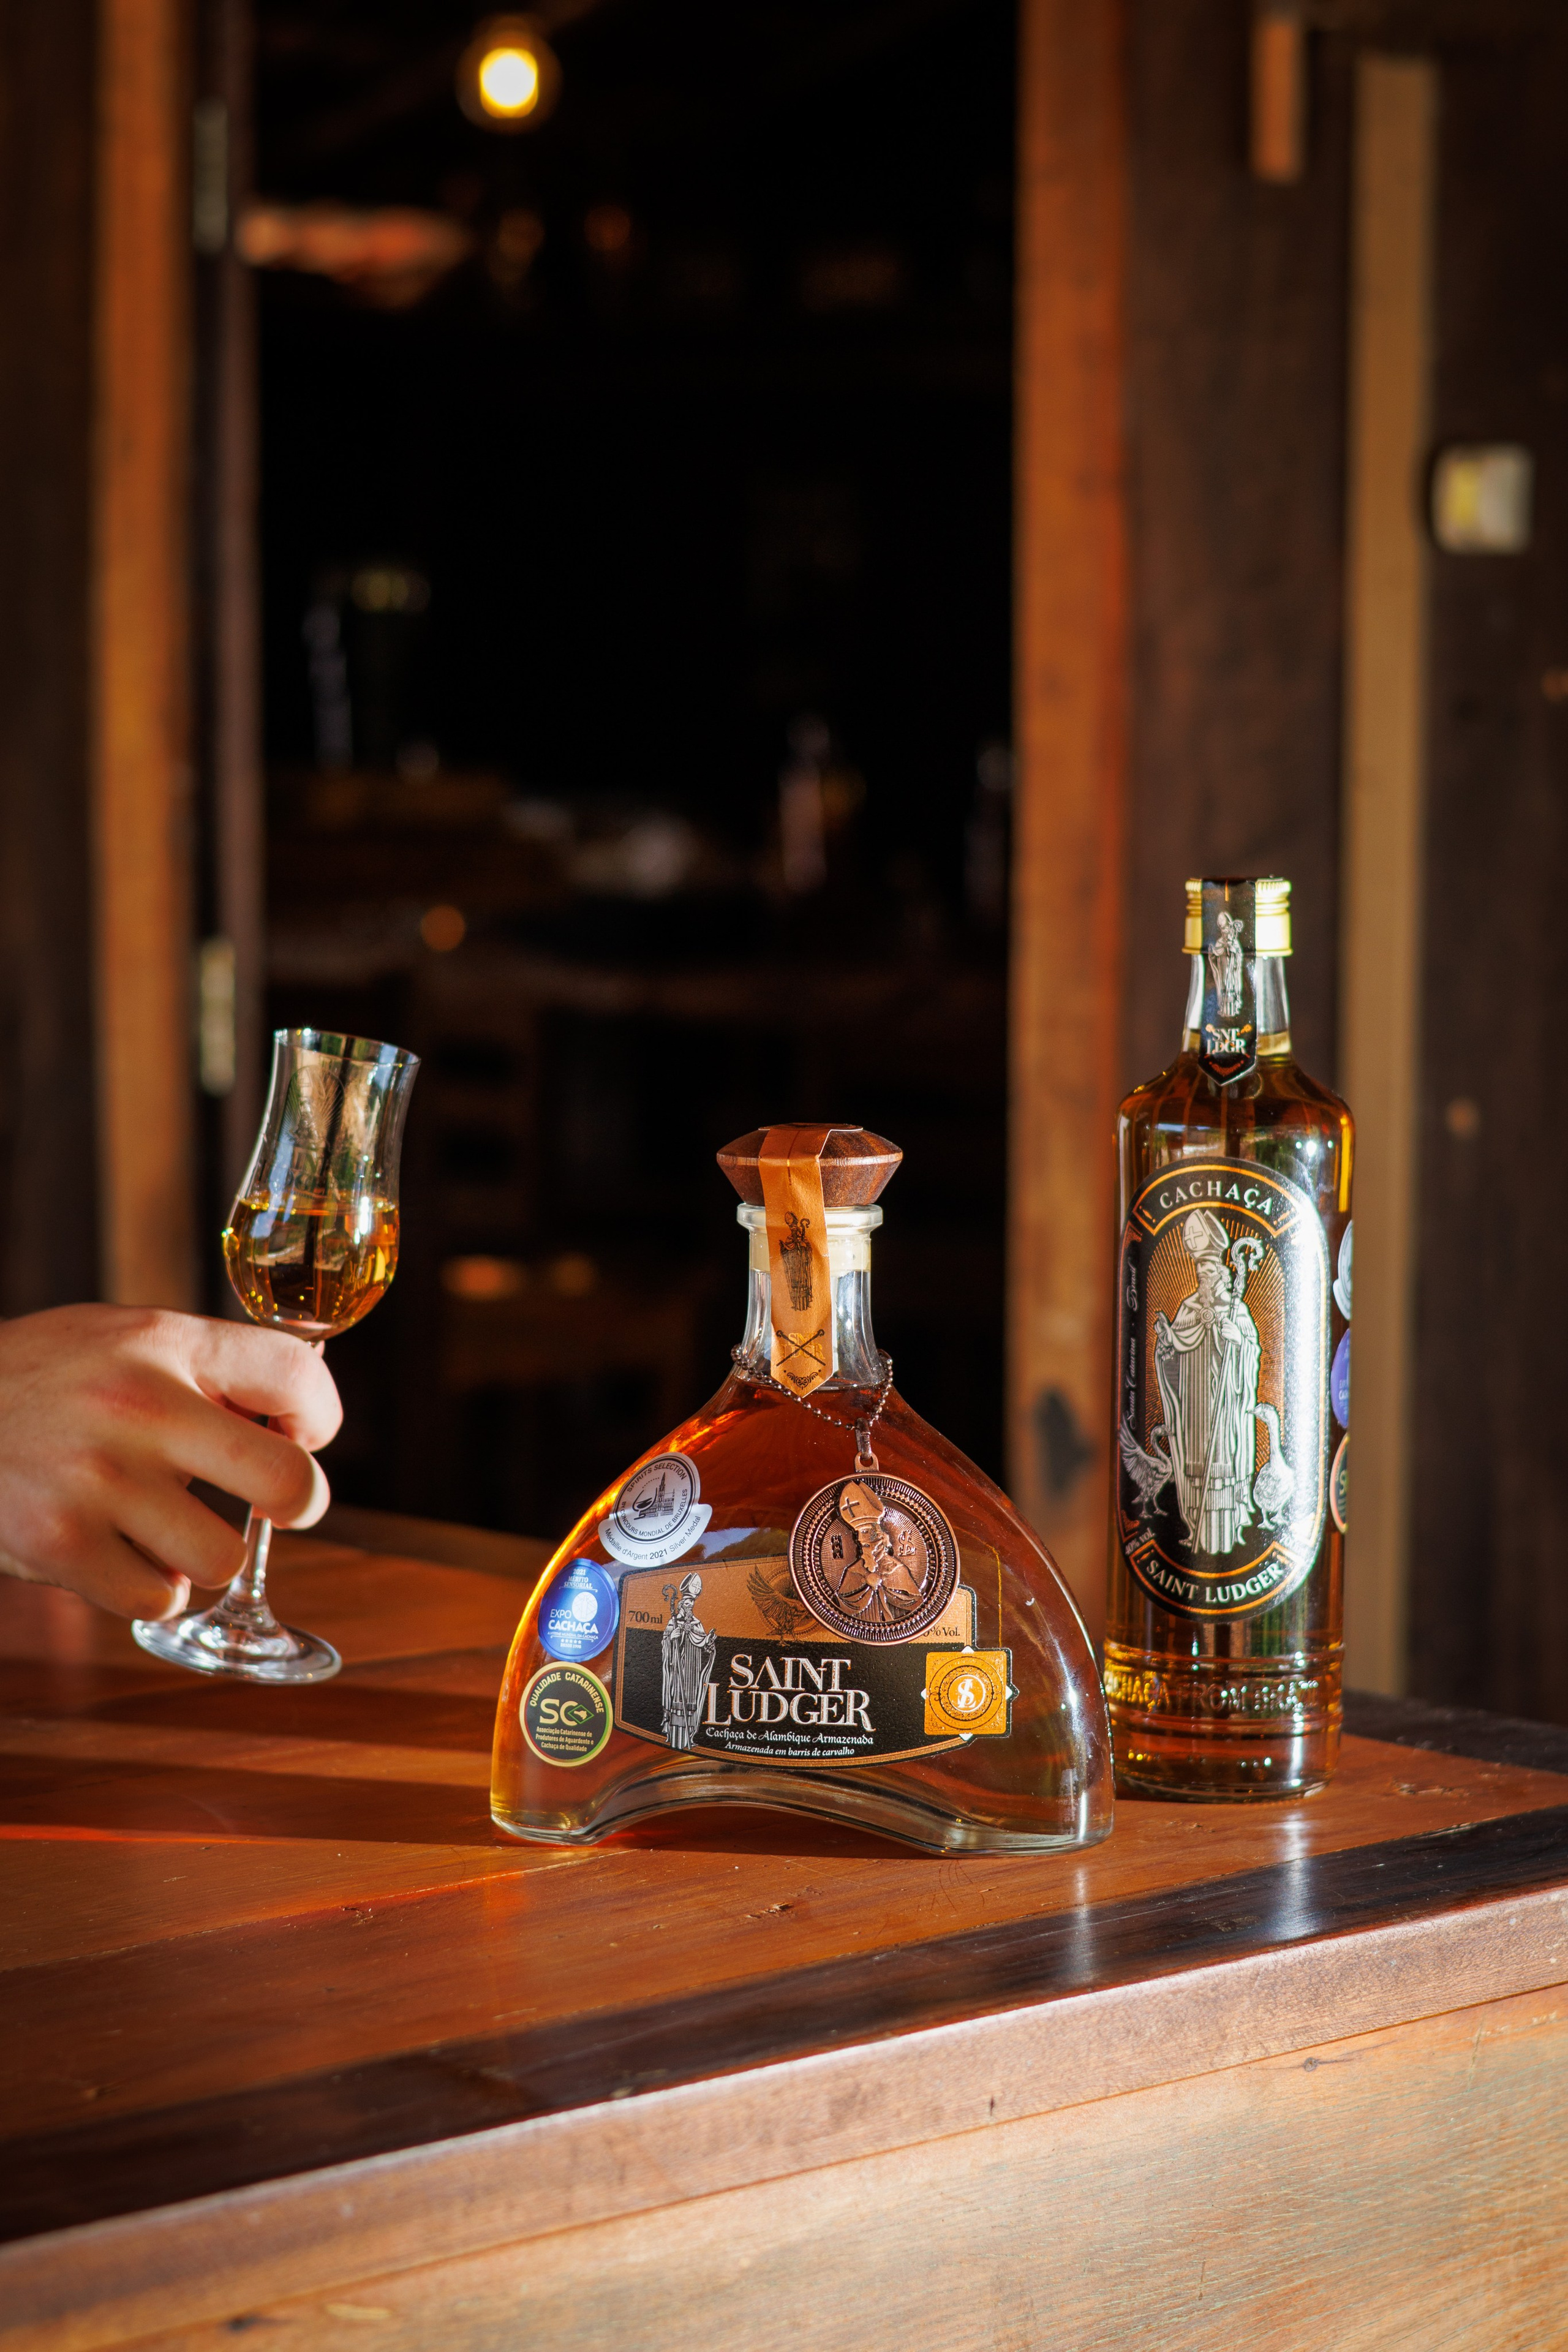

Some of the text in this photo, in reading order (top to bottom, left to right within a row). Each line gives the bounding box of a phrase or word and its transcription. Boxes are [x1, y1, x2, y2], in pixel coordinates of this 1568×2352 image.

[1207, 1039, 1246, 1055] LDGR
[1213, 1028, 1240, 1041] SNT
[1159, 1181, 1273, 1215] CACHAÇA
[627, 1463, 687, 1492] SPIRITS SELECTION
[620, 1509, 638, 1534] CONCOURS
[673, 1488, 687, 1523] BRUXELLES
[605, 1516, 701, 1561] Médaille d'Argent 2021 Silver Medal
[1147, 1559, 1284, 1604] SAINT LUDGER
[548, 1619, 599, 1634] CACHAÇA
[550, 1609, 571, 1619] EXPO
[943, 1626, 960, 1637] Vol.
[728, 1654, 851, 1693] SAINT
[530, 1672, 605, 1713] QUALIDADE CATARINENSE
[540, 1698, 578, 1726] SC
[702, 1682, 876, 1732] LUDGER
[537, 1726, 560, 1735] Associação
[706, 1727, 873, 1744] Cachaça de Alambique Armazenada
[725, 1741, 774, 1755] Armazenada
[788, 1748, 810, 1757] barris
[812, 1747, 821, 1756] de
[822, 1746, 854, 1755] carvalho
